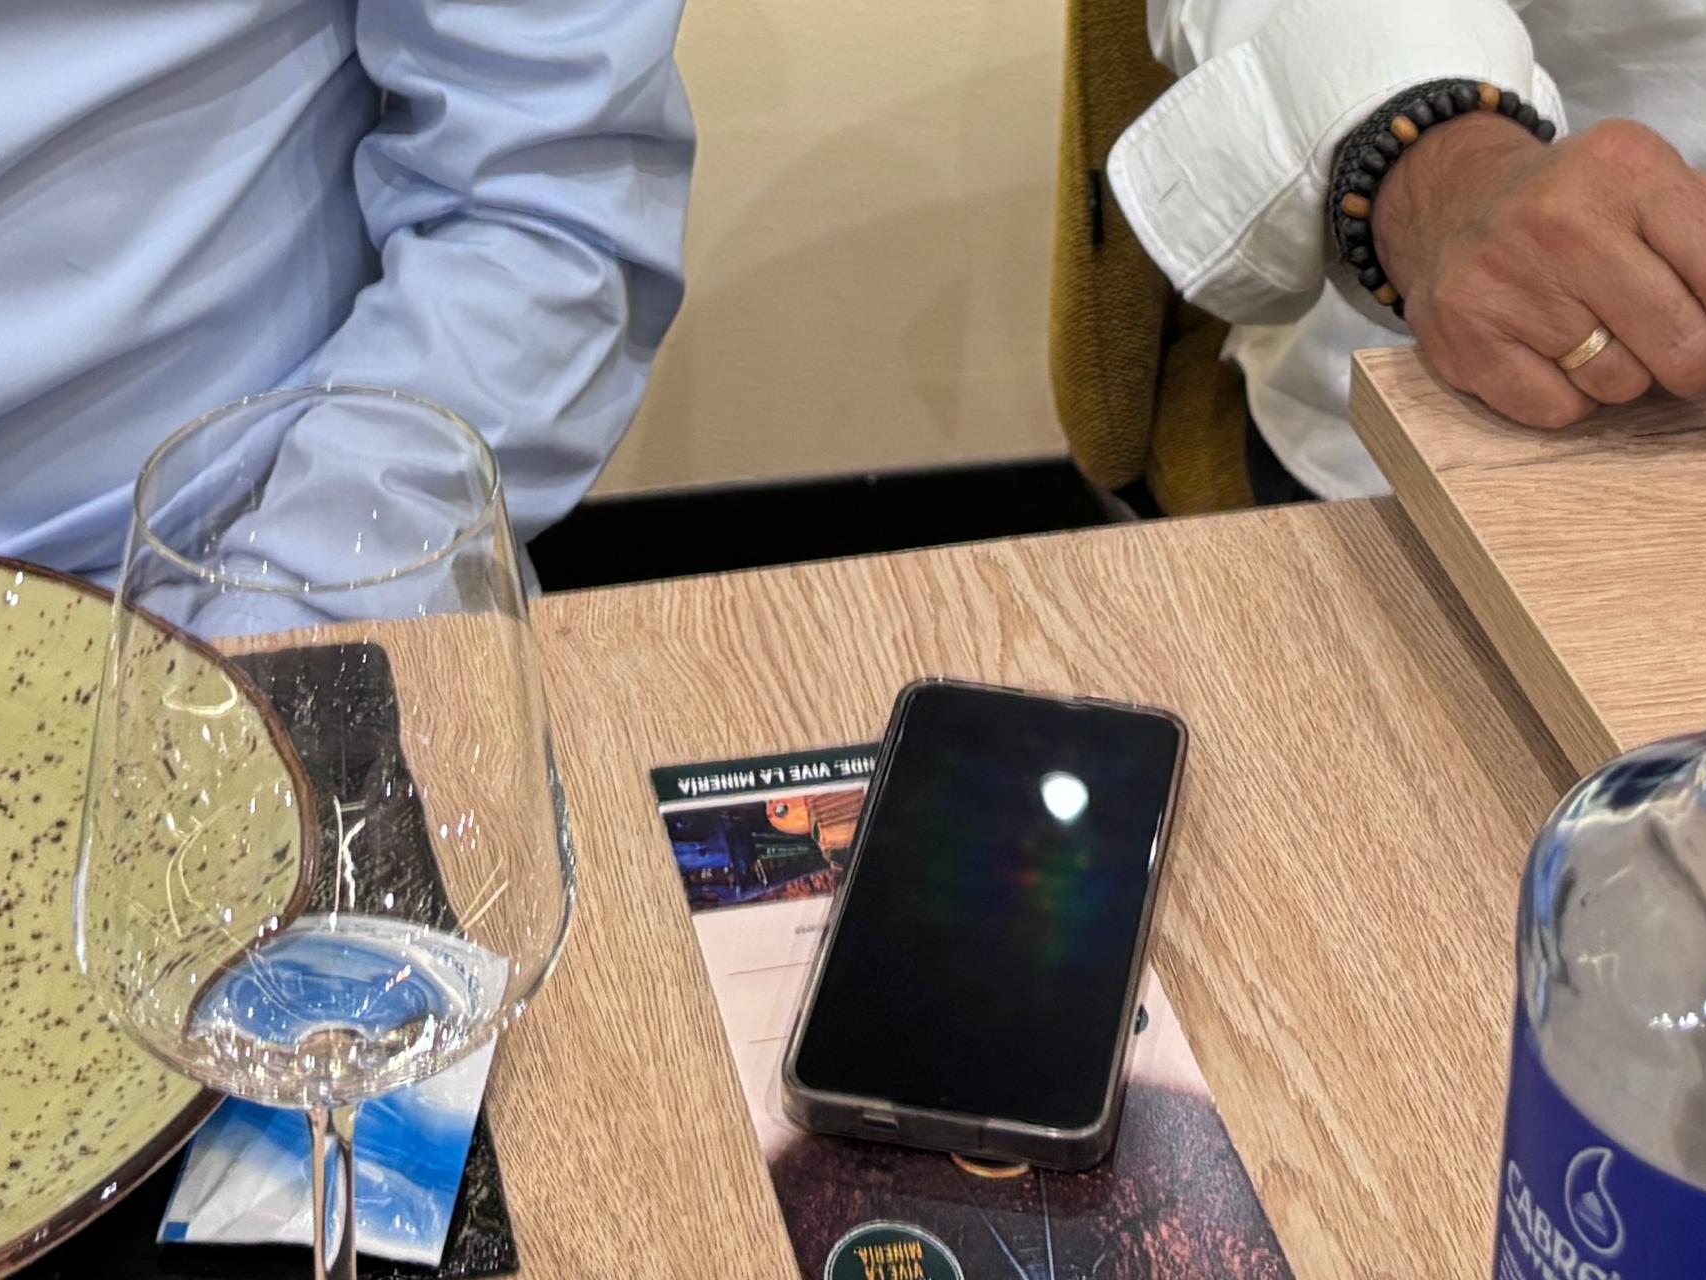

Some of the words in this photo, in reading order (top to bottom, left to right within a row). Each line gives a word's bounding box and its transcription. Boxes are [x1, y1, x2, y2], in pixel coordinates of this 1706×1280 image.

[759, 767, 786, 789] LA
[790, 762, 832, 782] VIVE
[677, 771, 757, 796] MINERÍA
